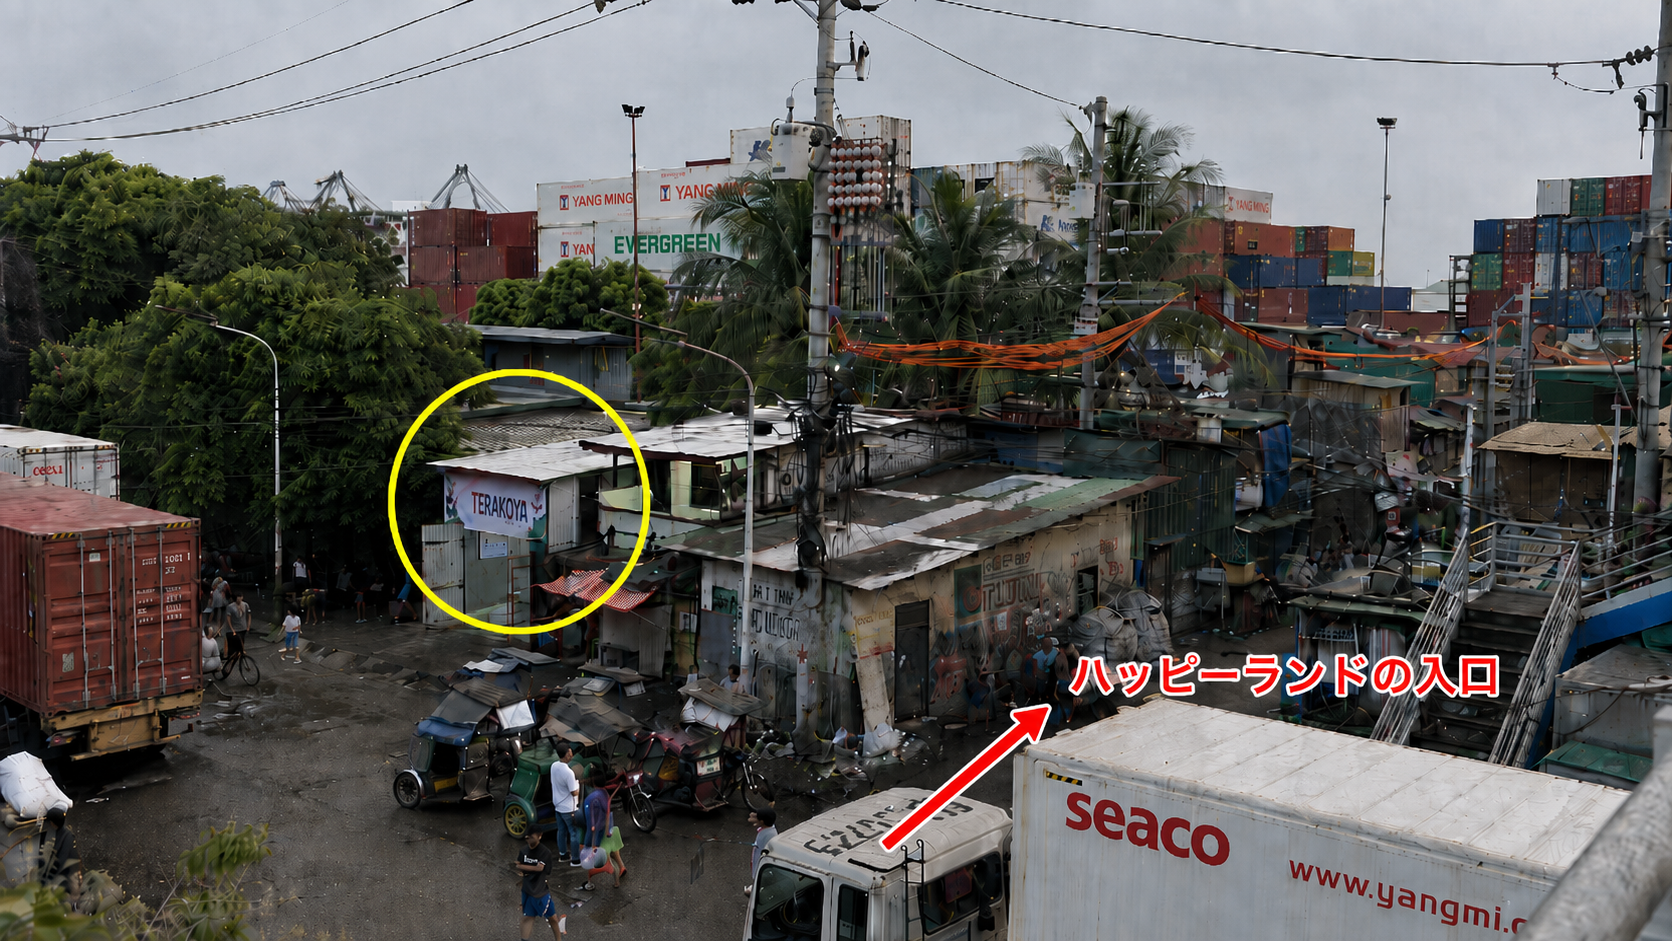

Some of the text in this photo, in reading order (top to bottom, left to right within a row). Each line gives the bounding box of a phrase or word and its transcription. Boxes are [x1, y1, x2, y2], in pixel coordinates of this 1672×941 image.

[572, 191, 633, 208] YANG MING
[675, 183, 714, 200] YANG
[1236, 199, 1252, 212] YANG
[614, 232, 721, 255] EVERGREEN
[471, 491, 528, 523] TERAKOYA
[1066, 792, 1230, 866] seaco
